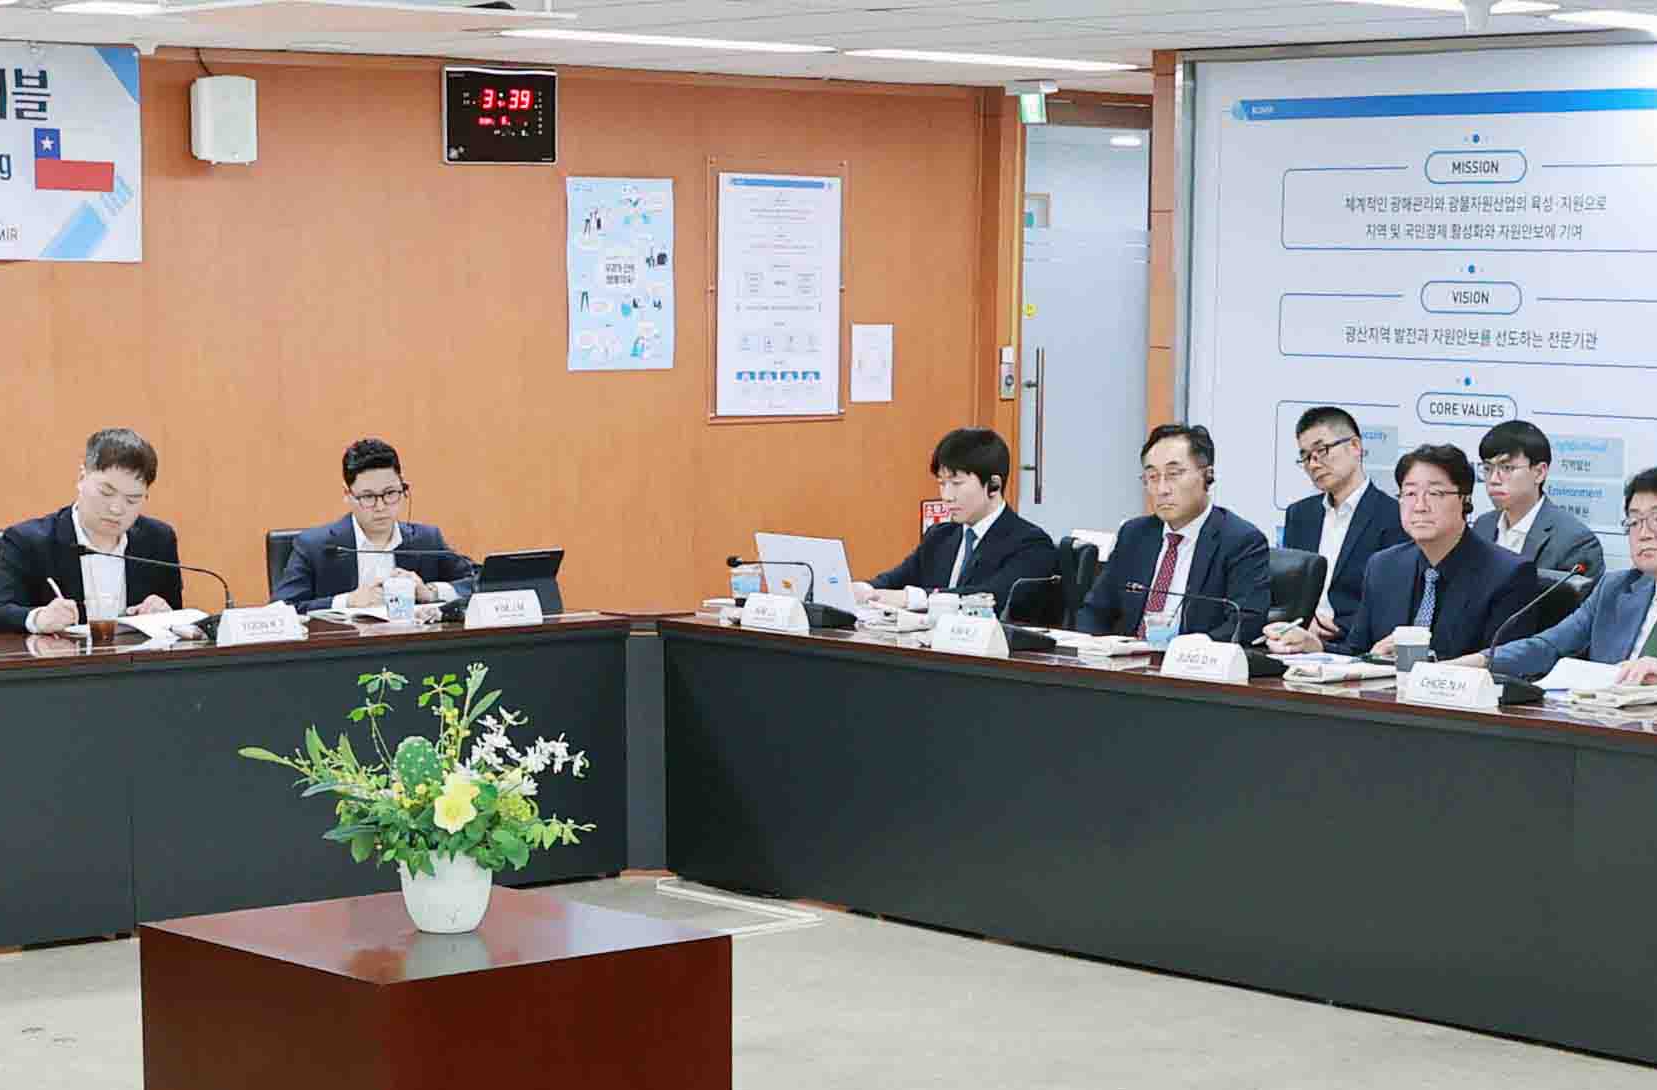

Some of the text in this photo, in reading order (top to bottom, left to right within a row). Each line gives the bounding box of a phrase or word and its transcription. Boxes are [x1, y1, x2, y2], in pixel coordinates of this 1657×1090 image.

[1451, 160, 1500, 175] MISSION
[1344, 195, 1388, 213] 체계적인
[1366, 223, 1389, 241] 지역
[1405, 223, 1448, 241] 국민경제
[1560, 223, 1583, 241] 기여
[1452, 290, 1490, 305] VISION
[1345, 325, 1599, 351] 광산지역 발전과 자원안보를 선도하는 전문기관
[1429, 402, 1505, 419] CORE VALUES
